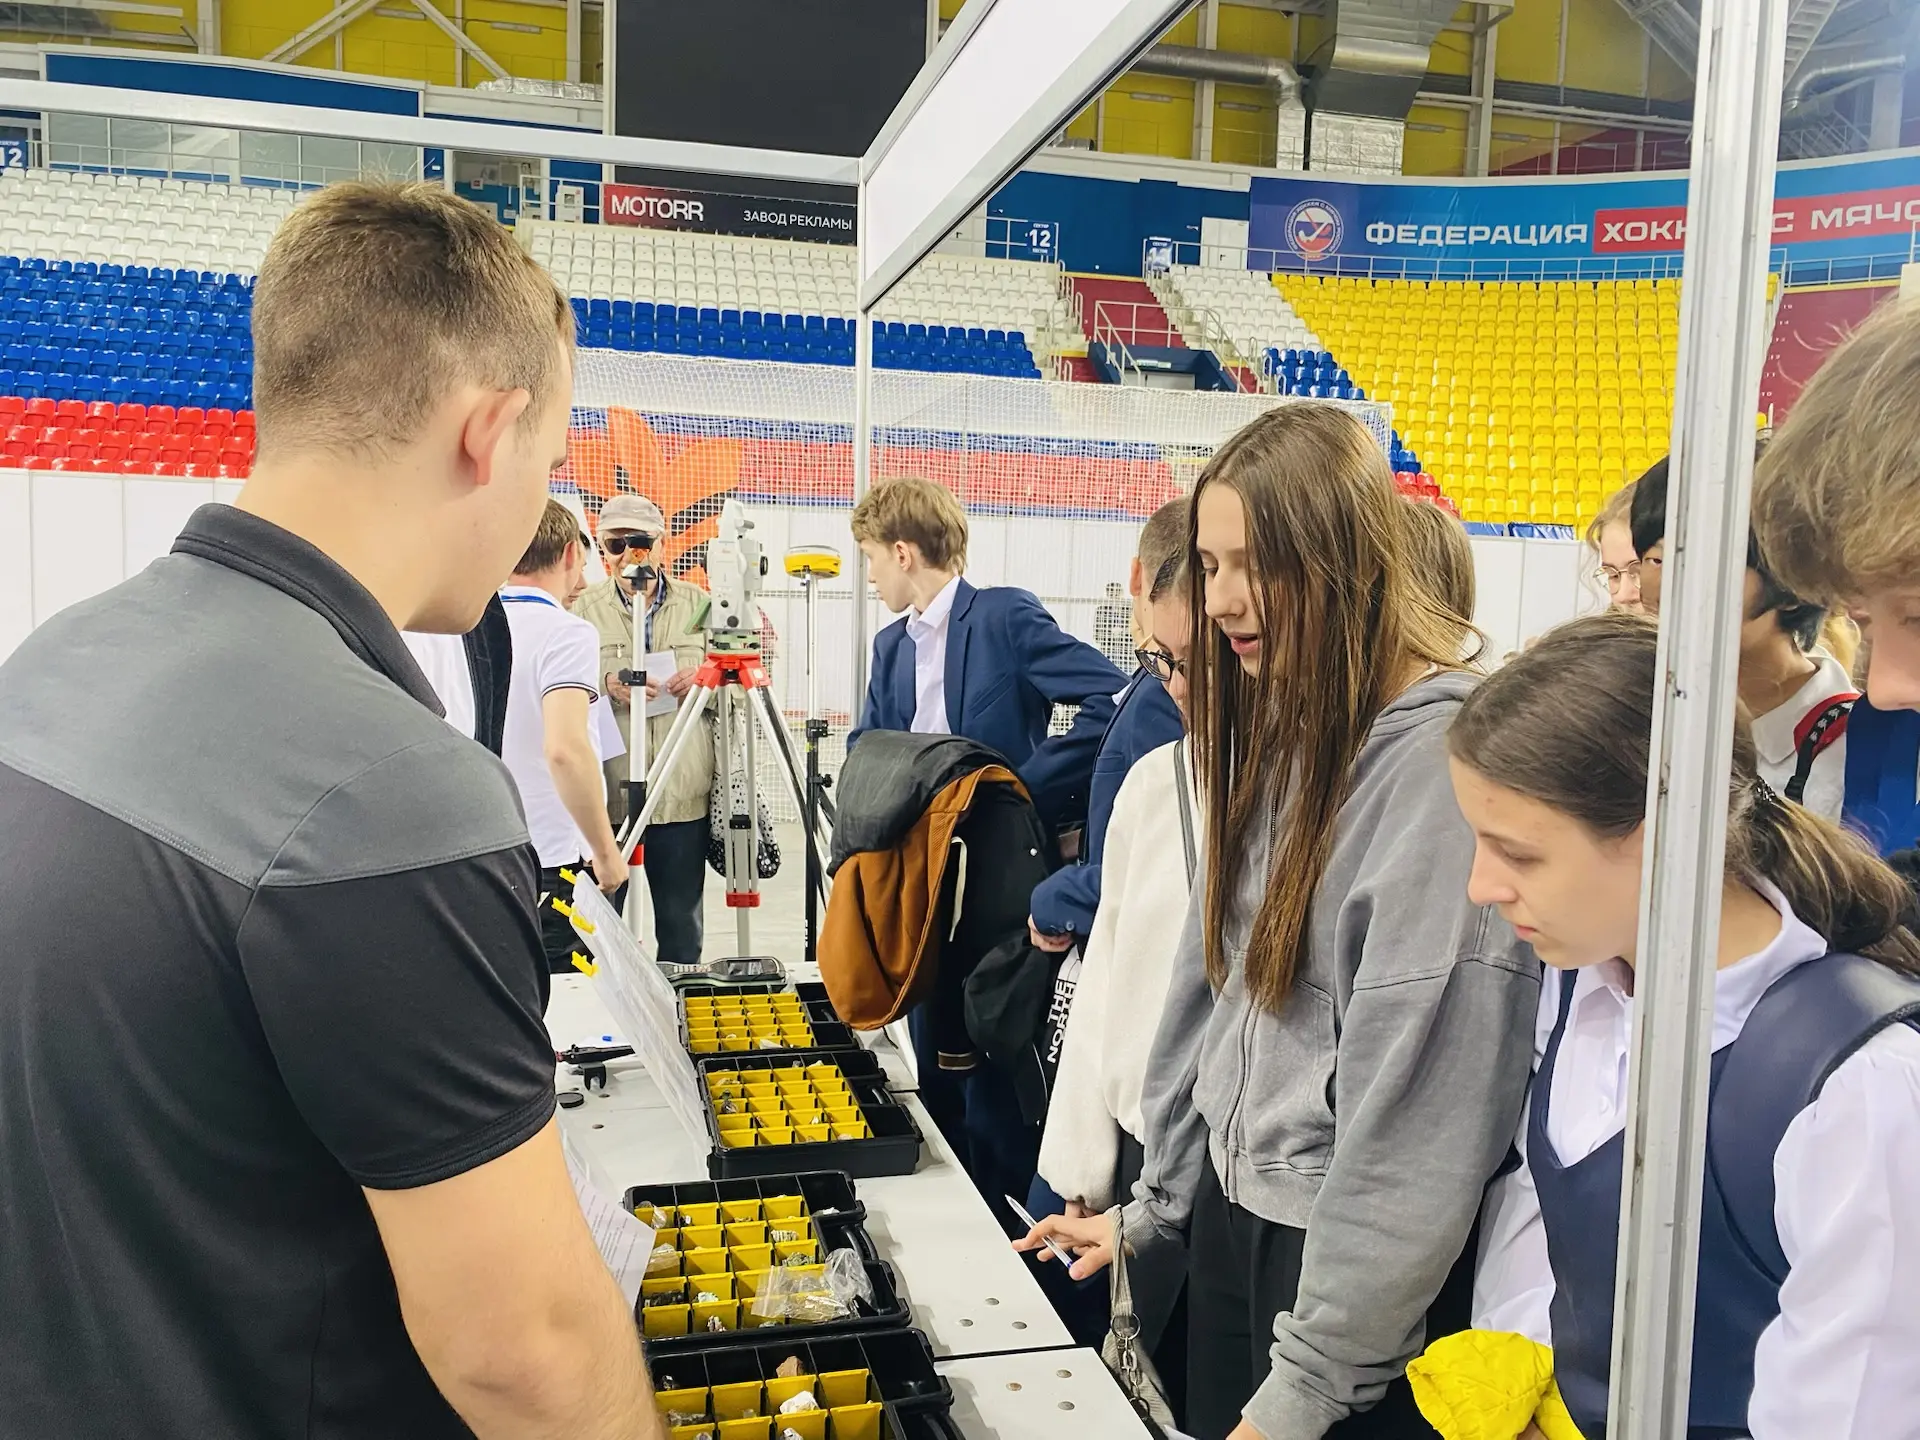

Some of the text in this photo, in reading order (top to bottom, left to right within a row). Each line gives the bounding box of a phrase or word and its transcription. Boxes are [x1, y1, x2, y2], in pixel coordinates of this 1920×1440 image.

[0, 147, 23, 167] 12
[611, 194, 704, 221] MOTORR
[743, 210, 852, 230] ЗАВОД РЕКЛАМЫ
[1366, 222, 1588, 247] ФЕДЕРАЦИЯ
[1601, 220, 1687, 242] ХОК
[1771, 212, 1795, 233] С
[1030, 229, 1051, 247] 12
[1047, 979, 1067, 1023] THE
